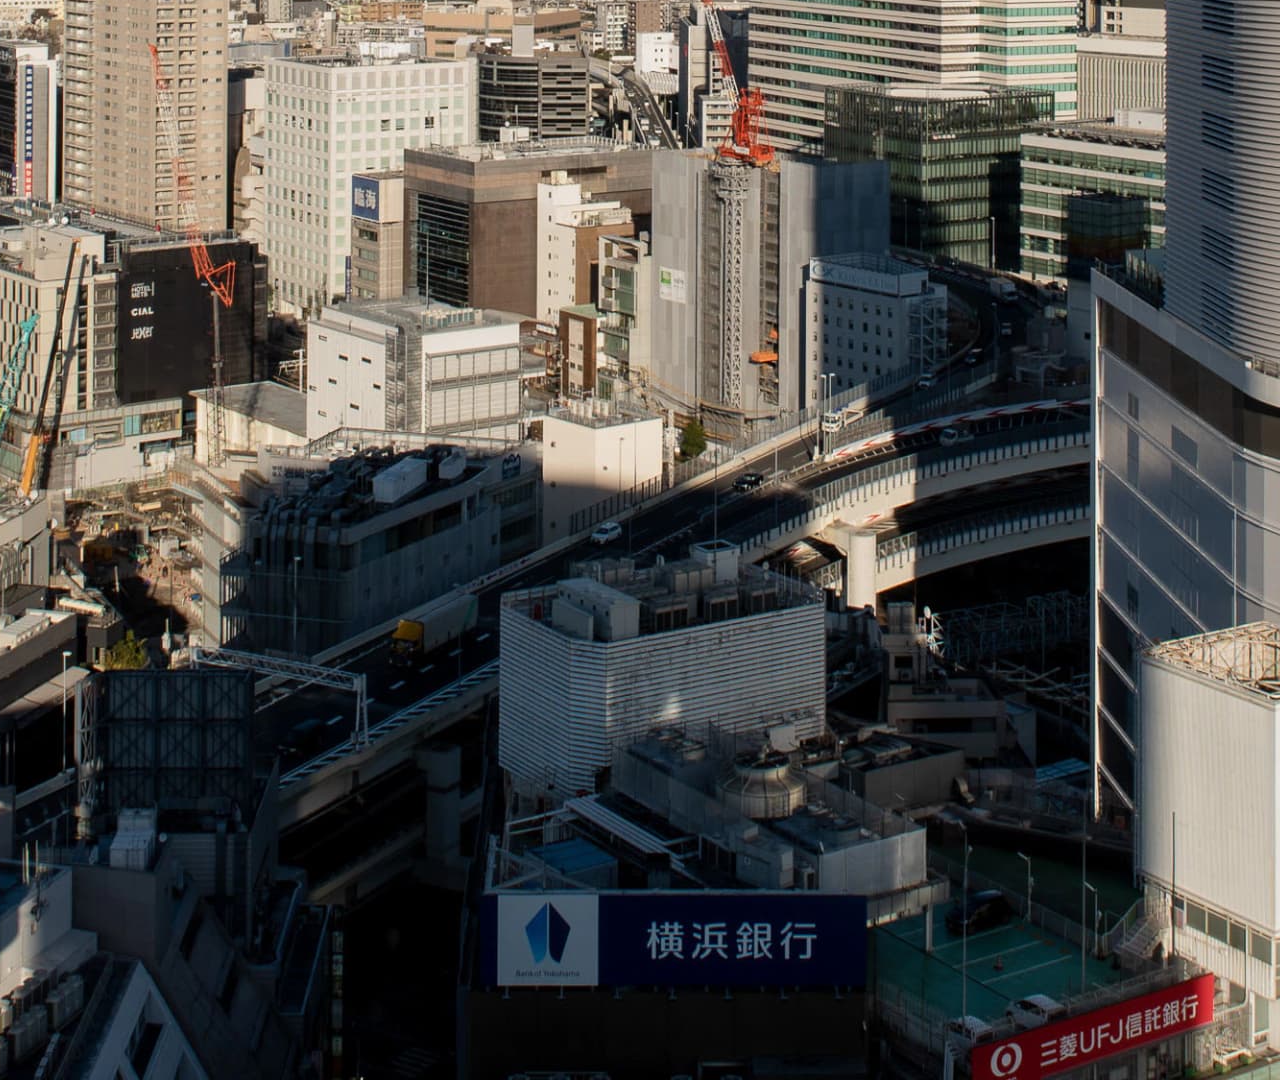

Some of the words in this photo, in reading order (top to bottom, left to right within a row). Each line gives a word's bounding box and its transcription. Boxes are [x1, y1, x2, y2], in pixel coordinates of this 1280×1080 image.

[130, 306, 154, 317] CIAL
[646, 921, 818, 961] 横浜銀行
[515, 969, 534, 977] Bank
[543, 969, 580, 977] Yokohama
[1040, 994, 1199, 1068] 三菱UFJ信託銀行
